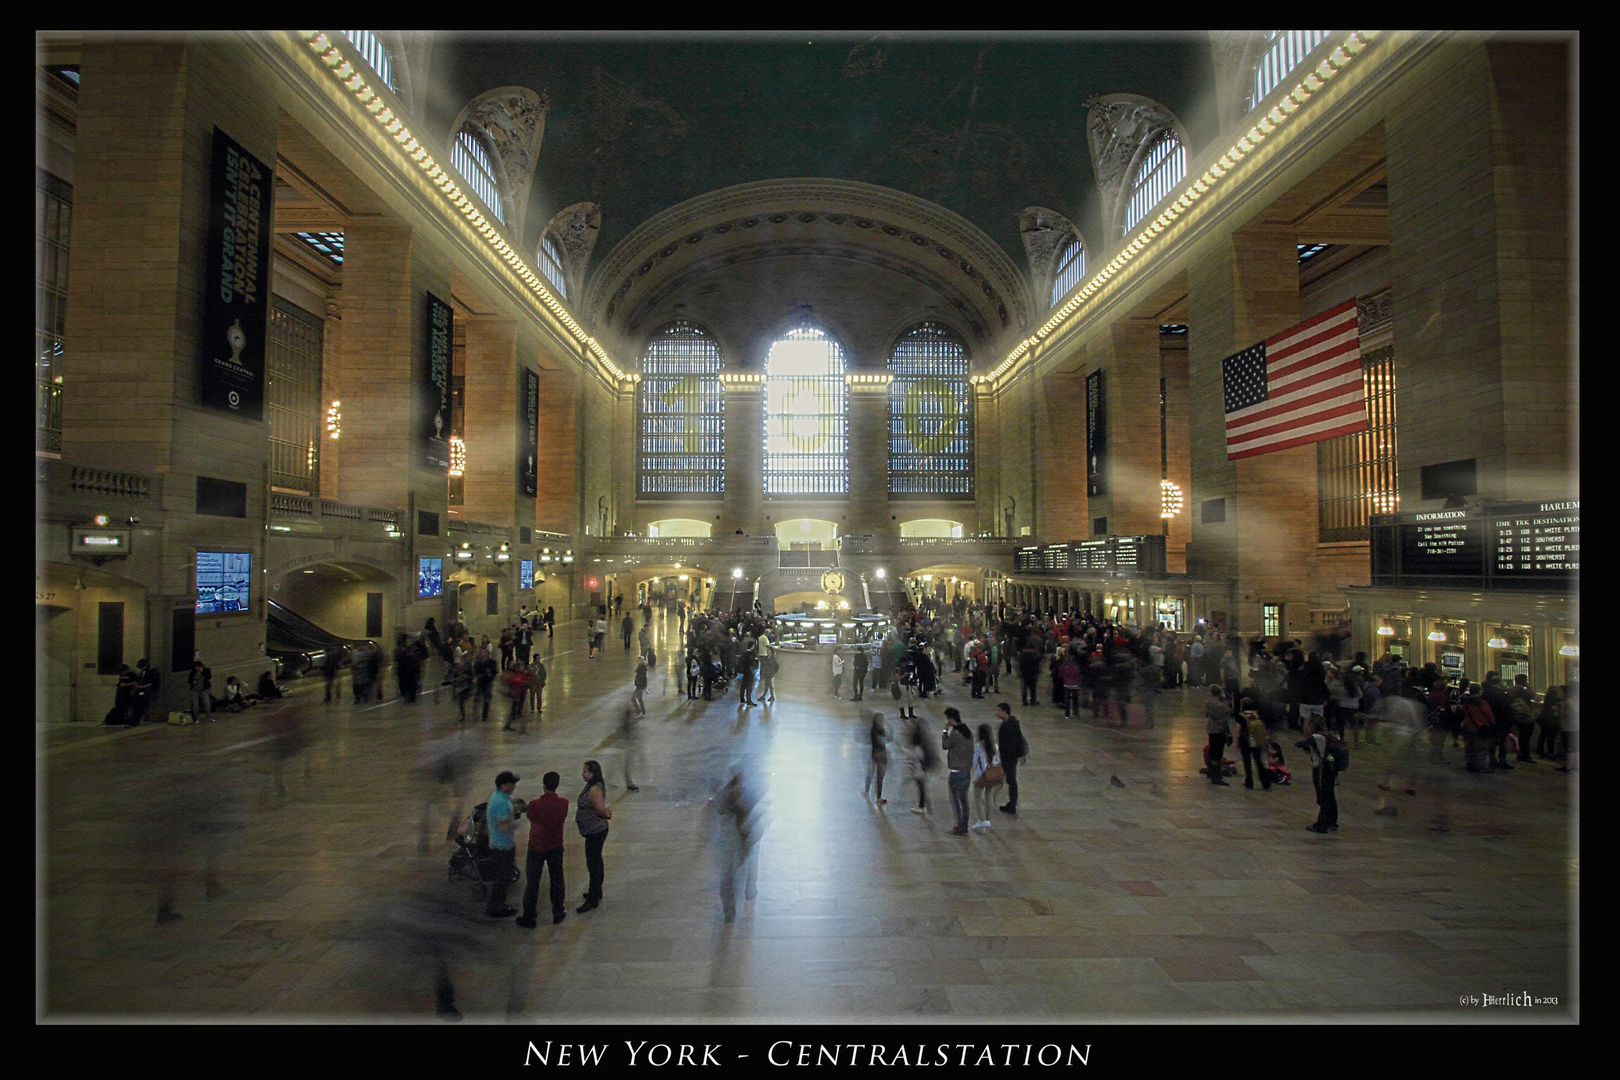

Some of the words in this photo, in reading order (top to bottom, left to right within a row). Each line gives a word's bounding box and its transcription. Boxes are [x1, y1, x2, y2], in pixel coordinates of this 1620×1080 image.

[225, 146, 240, 205] ISN'T
[250, 162, 262, 180] A
[224, 202, 237, 227] IT
[234, 157, 251, 295] CELEBRATION
[244, 184, 261, 304] CENTENNIAL
[221, 226, 235, 304] GRAND
[1416, 510, 1466, 521] INFORMATION
[1545, 544, 1562, 552] WHITE
[1545, 562, 1563, 570] WHITE
[45, 592, 56, 600] 27
